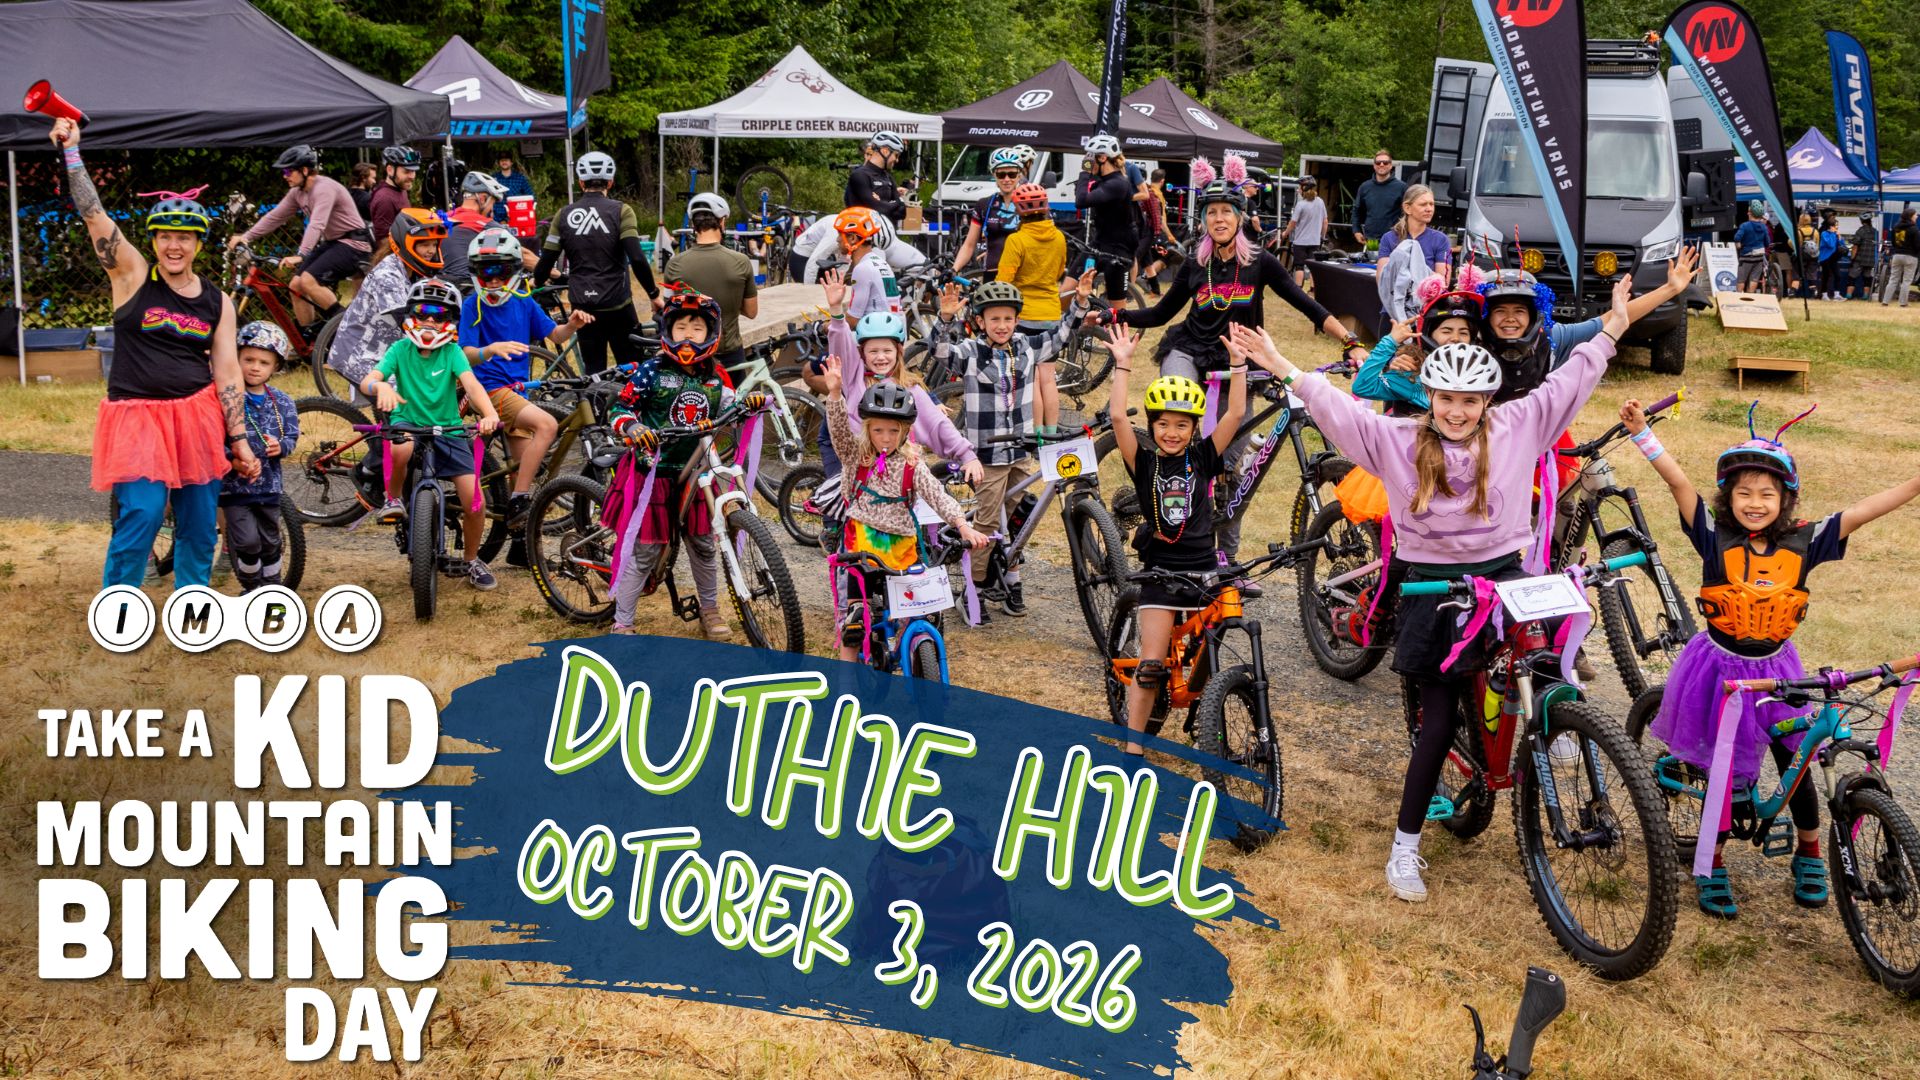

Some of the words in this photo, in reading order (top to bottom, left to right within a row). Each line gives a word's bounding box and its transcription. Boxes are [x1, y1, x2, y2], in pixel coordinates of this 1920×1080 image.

[1487, 20, 1499, 42] YOUR
[1495, 44, 1515, 85] LIFESTYLE
[1511, 86, 1517, 96] IN
[1514, 98, 1529, 129] MOTION
[1500, 14, 1551, 128] MOMENTUM
[1545, 136, 1573, 190] VANS
[1688, 62, 1700, 80] YOUR
[1699, 80, 1718, 109] LIFESTYLE
[1716, 108, 1723, 117] IN
[1720, 116, 1737, 139] MOTION
[1845, 53, 1868, 167] PIVOT
[741, 119, 792, 131] CRIPPLE
[796, 120, 834, 131] CREEK
[838, 120, 919, 134] BACKCOUNTRY
[968, 127, 1039, 138] MONDRAKER
[1126, 137, 1168, 147] MONDRAKER
[1698, 55, 1752, 136] MOMENTUM
[1750, 140, 1779, 179] VANS
[1844, 116, 1852, 154] CYCLES
[1227, 408, 1290, 519] NORCO
[1537, 752, 1559, 808] RAIDON
